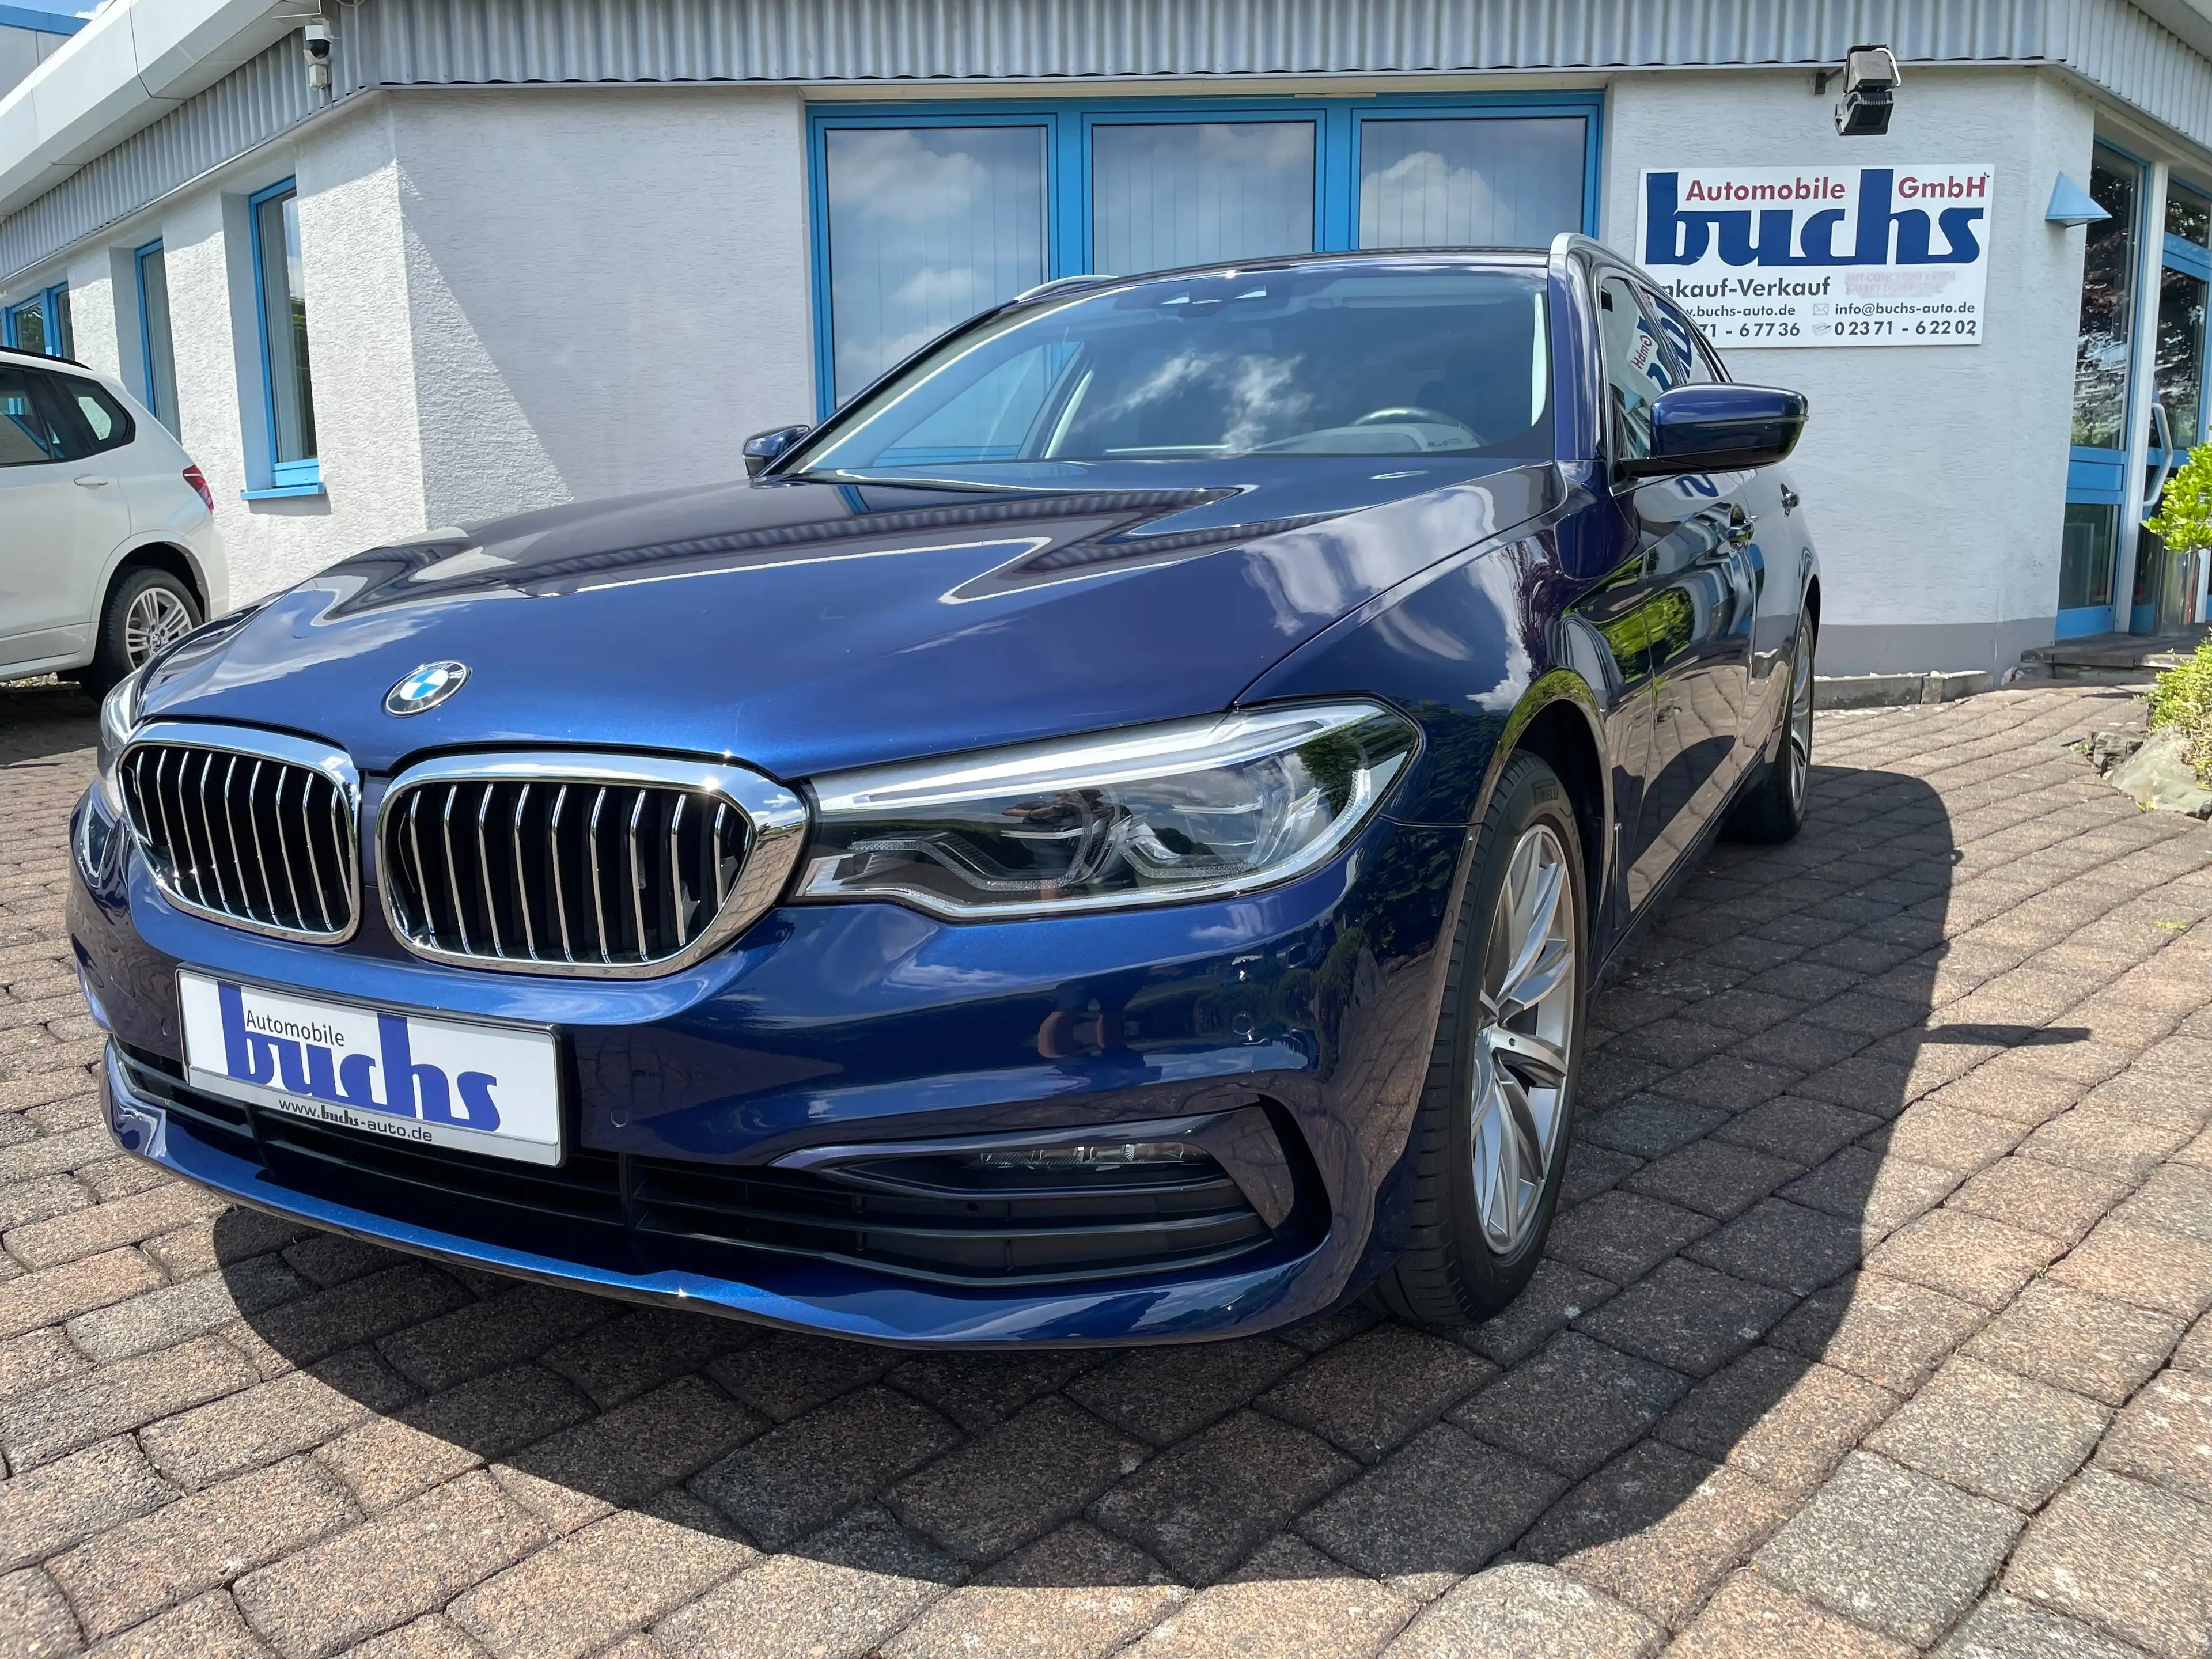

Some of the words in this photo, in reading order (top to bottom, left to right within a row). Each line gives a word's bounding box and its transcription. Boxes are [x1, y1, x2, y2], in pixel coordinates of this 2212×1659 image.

[1685, 177, 1846, 201] Automobile
[1898, 176, 1986, 198] GmbH
[1645, 169, 1984, 266] buchs
[1661, 276, 1830, 298] nkauf-Verkauf
[1835, 301, 1975, 316] info@buchs-auto.de
[246, 1010, 344, 1047] Automobile
[218, 981, 501, 1132] buchs
[279, 1099, 433, 1142] www.buchs-auto.de
